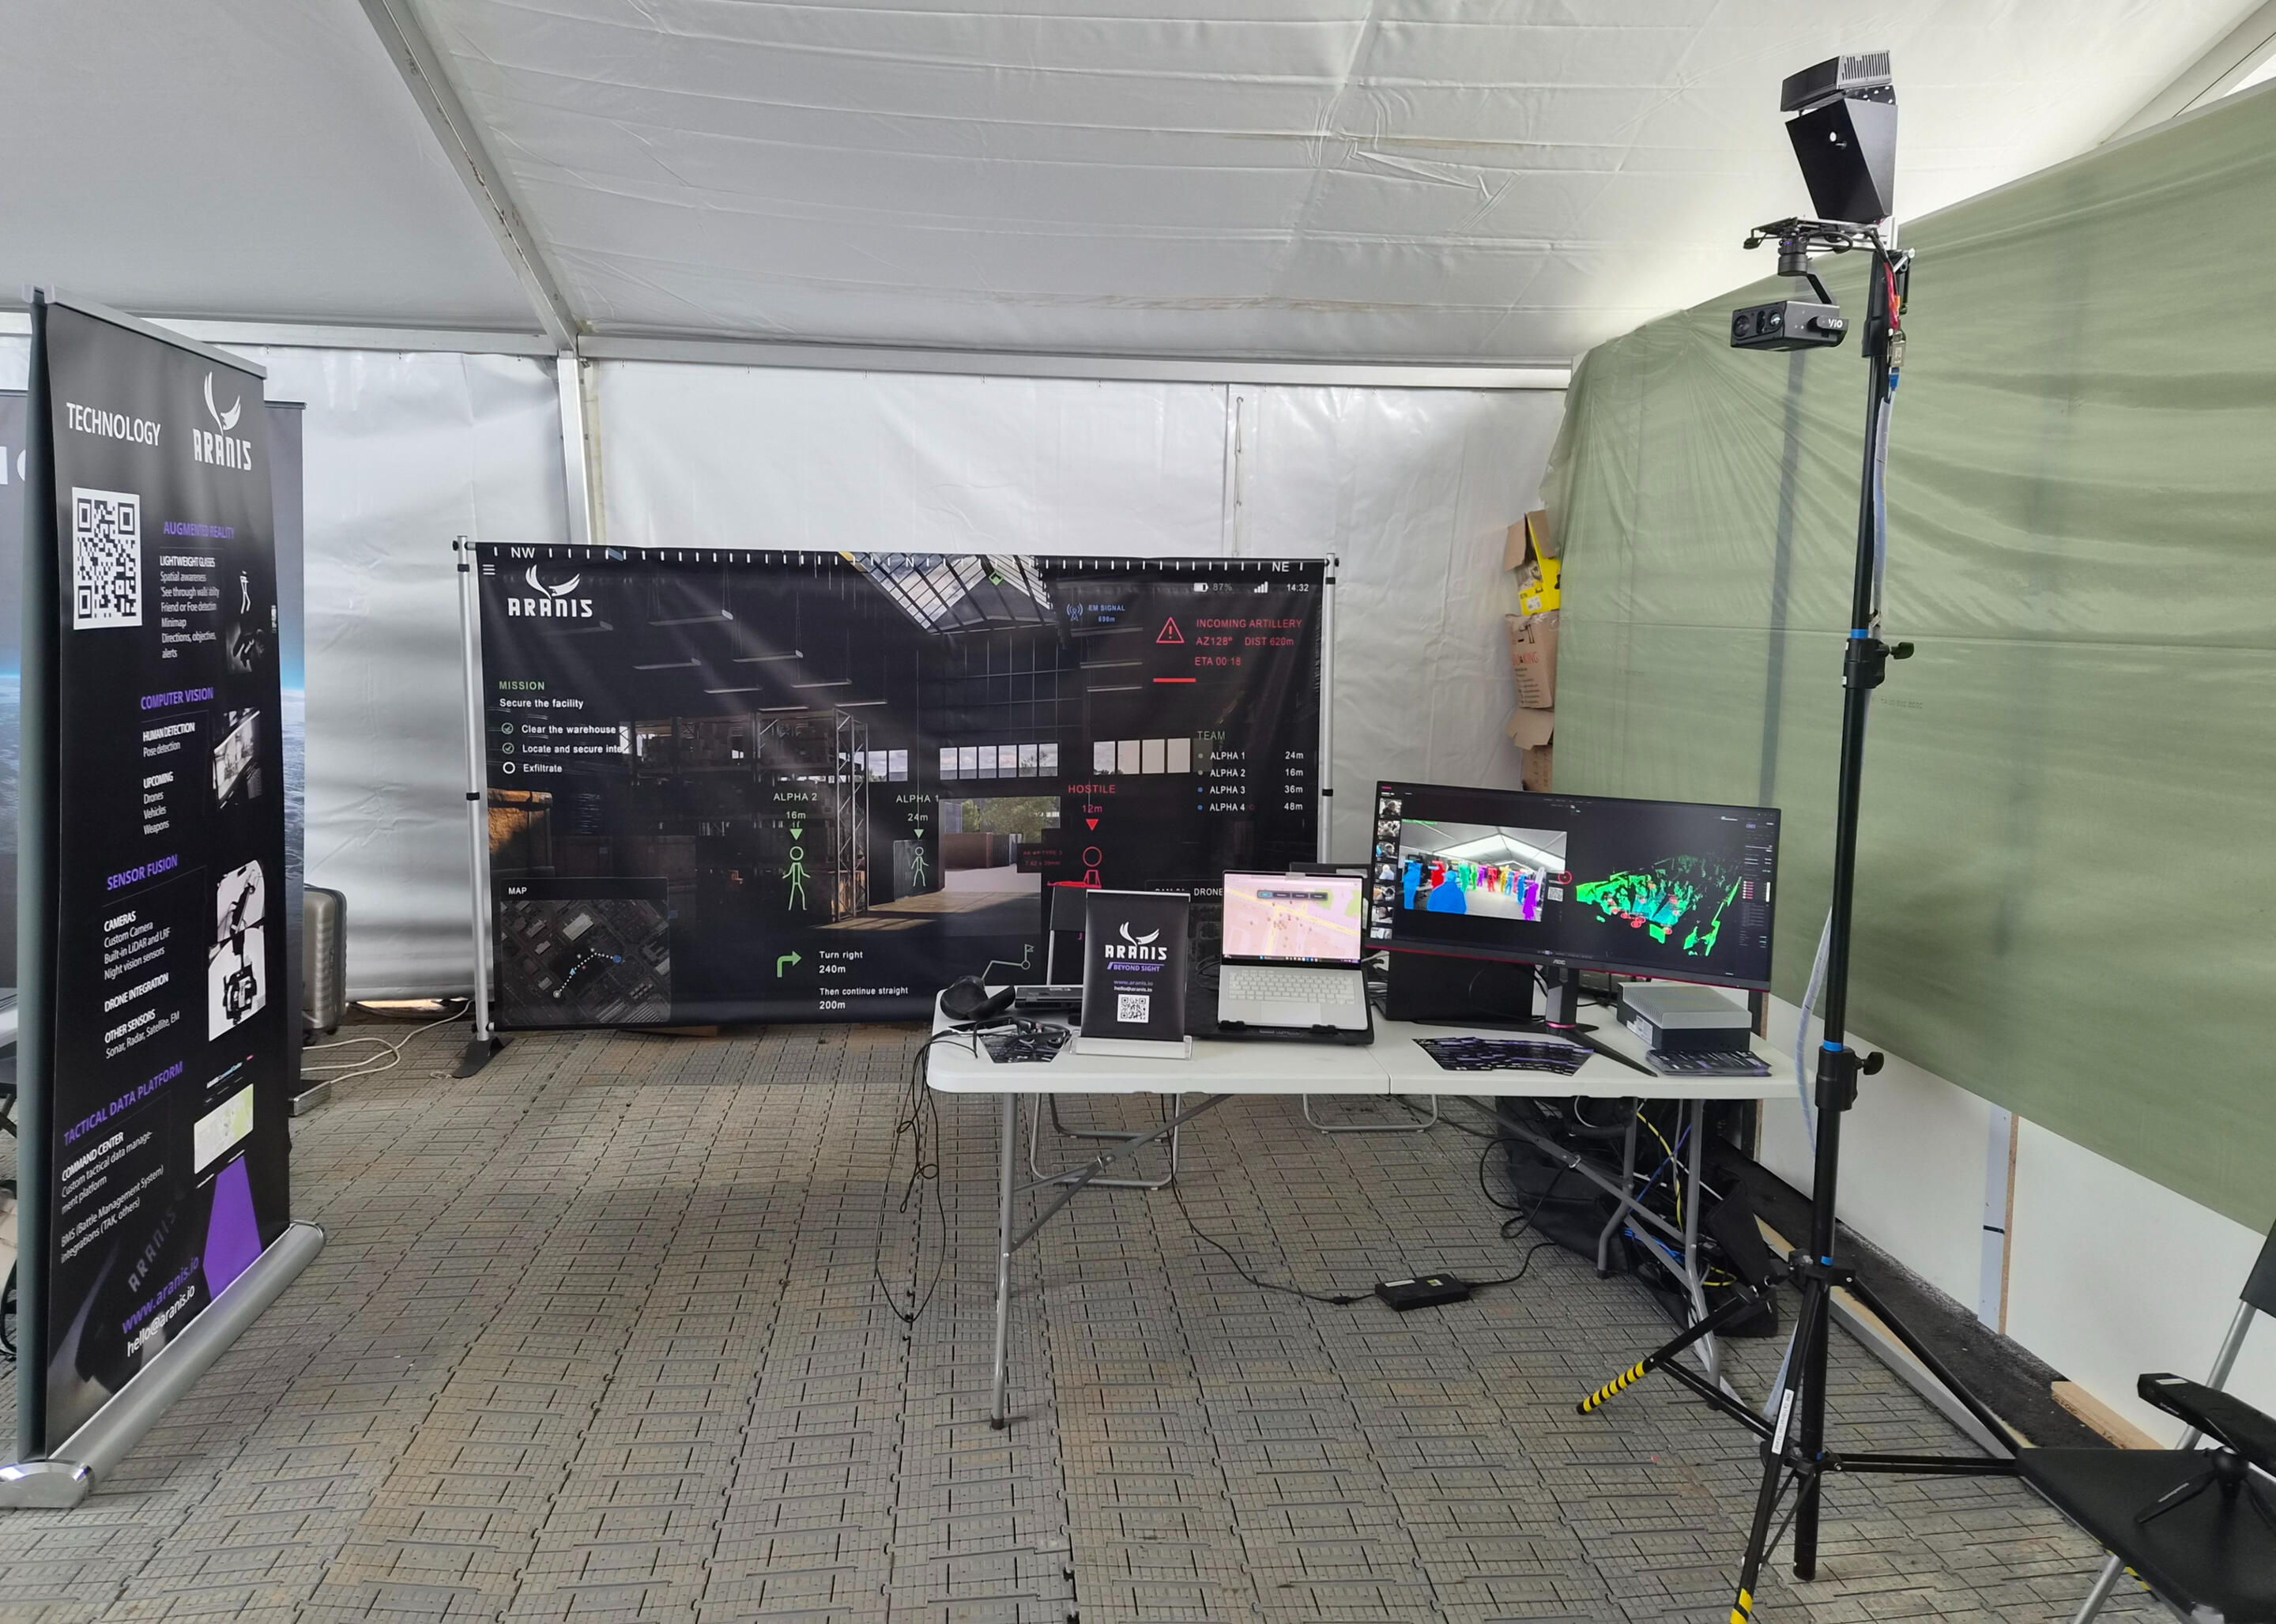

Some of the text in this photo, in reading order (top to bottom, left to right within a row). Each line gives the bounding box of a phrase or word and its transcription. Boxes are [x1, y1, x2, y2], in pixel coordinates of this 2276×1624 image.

[66, 401, 161, 447] TECHNOLOGY
[192, 428, 252, 471] ARANIS
[164, 521, 235, 540] AUGMENTED REALITY
[511, 547, 535, 558] NW
[160, 556, 199, 567] LIGHTWEIGHT
[906, 556, 914, 567] N
[1272, 561, 1290, 573] NE
[160, 571, 207, 583] Spatial awareness
[172, 586, 197, 599] through
[1212, 582, 1233, 592] 87%
[1286, 583, 1309, 593] 14:32
[160, 601, 179, 612] Friend
[179, 604, 187, 612] or
[187, 601, 198, 612] Foe
[507, 597, 593, 618] ARANIS
[161, 617, 187, 629] Minimap
[1196, 619, 1302, 629] INCOMING ARTILLERY
[161, 631, 192, 643] Directions,
[1245, 637, 1267, 646] DIST
[1269, 637, 1294, 646] 620m
[162, 648, 178, 658] alerts
[1194, 657, 1242, 666] ETA 00:18
[499, 681, 545, 690] MISSION
[141, 687, 214, 710] COMPUTER VISION
[499, 699, 584, 710] Secure the facility
[142, 722, 195, 742] HUMAN DETECTION
[522, 725, 616, 734] Clear the warehouse
[1197, 731, 1226, 740] TEAM
[143, 740, 181, 758] Pose detection
[522, 744, 552, 754] Locate
[554, 744, 571, 754] and
[573, 745, 604, 754] secure
[1210, 752, 1239, 760] ALPHA
[1241, 752, 1245, 760] 1
[523, 763, 563, 773] Exfiltrate
[143, 771, 174, 789] UPCOMING
[1068, 785, 1116, 793] HOSTILE
[1210, 786, 1238, 794] ALPHA
[1239, 786, 1245, 794] 3
[143, 791, 164, 804] Drones
[773, 793, 817, 801] ALPHA 2
[896, 794, 939, 803] ALPHA 1
[143, 805, 167, 820] Vehicles
[1082, 804, 1103, 813] 12m
[1209, 802, 1303, 812] ALPHA 4 48m
[786, 811, 806, 820] 16m
[143, 820, 170, 835] Weapons
[107, 854, 179, 891] SENSOR FUSION
[1194, 887, 1223, 896] DRONE
[104, 910, 137, 933] CAMERAS
[104, 921, 153, 948] Custom Camera
[104, 927, 171, 964] Built-in LiDAR and LRF
[842, 951, 863, 961] right
[1105, 944, 1168, 961] ARANIS
[104, 946, 165, 981] Night vision sensors
[819, 965, 846, 974] 240m
[1141, 963, 1161, 972] SIGHT
[104, 972, 169, 1012] DRONE INTEGRATION
[878, 986, 909, 997] straight
[819, 1000, 846, 1009] 200m
[104, 1008, 156, 1044] OTHER SENSORS
[106, 1010, 180, 1060] Sonar, Radar, Satellite, EM
[64, 1108, 108, 1146] TACTICAL
[109, 1092, 137, 1117] DATA
[138, 1061, 184, 1101] PLATFORM
[61, 1131, 124, 1182] COMMAND CENTER
[61, 1130, 153, 1198] Custom tactical data manage-
[61, 1175, 107, 1215] ment platform
[61, 1164, 164, 1248] BMS (Battle Management System)
[61, 1196, 141, 1264] integrations (TAK, others)
[127, 1206, 176, 1293] ARANIS
[122, 1256, 200, 1334] www.aranis.io
[126, 1284, 196, 1358] hello@aranis.io
